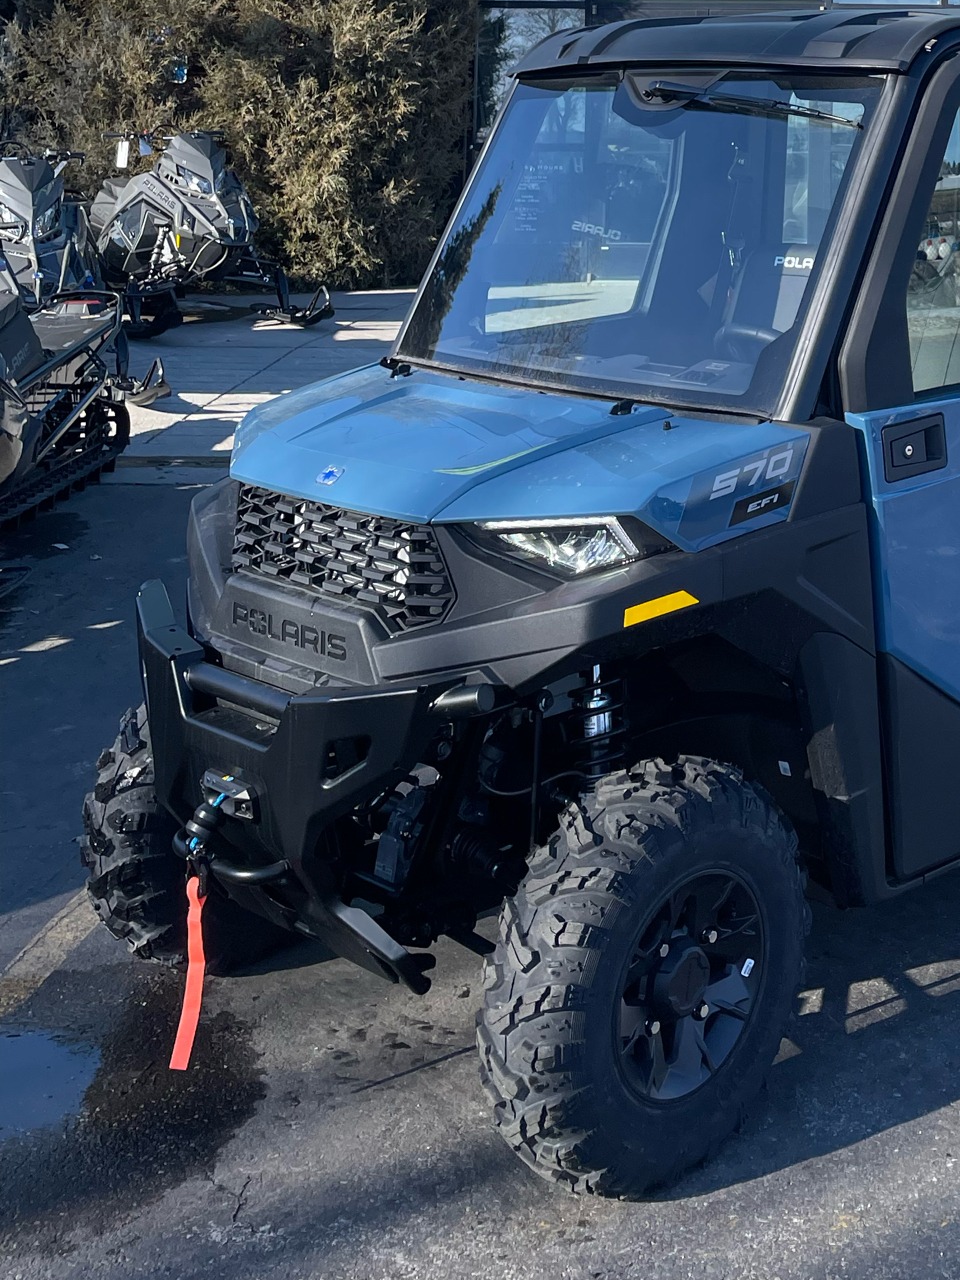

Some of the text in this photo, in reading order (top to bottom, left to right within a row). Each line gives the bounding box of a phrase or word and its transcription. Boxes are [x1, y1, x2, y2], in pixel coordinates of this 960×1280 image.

[142, 177, 176, 210] POLARIS
[709, 448, 794, 500] 570
[747, 493, 779, 513] EFI
[232, 601, 347, 662] POLARIS
